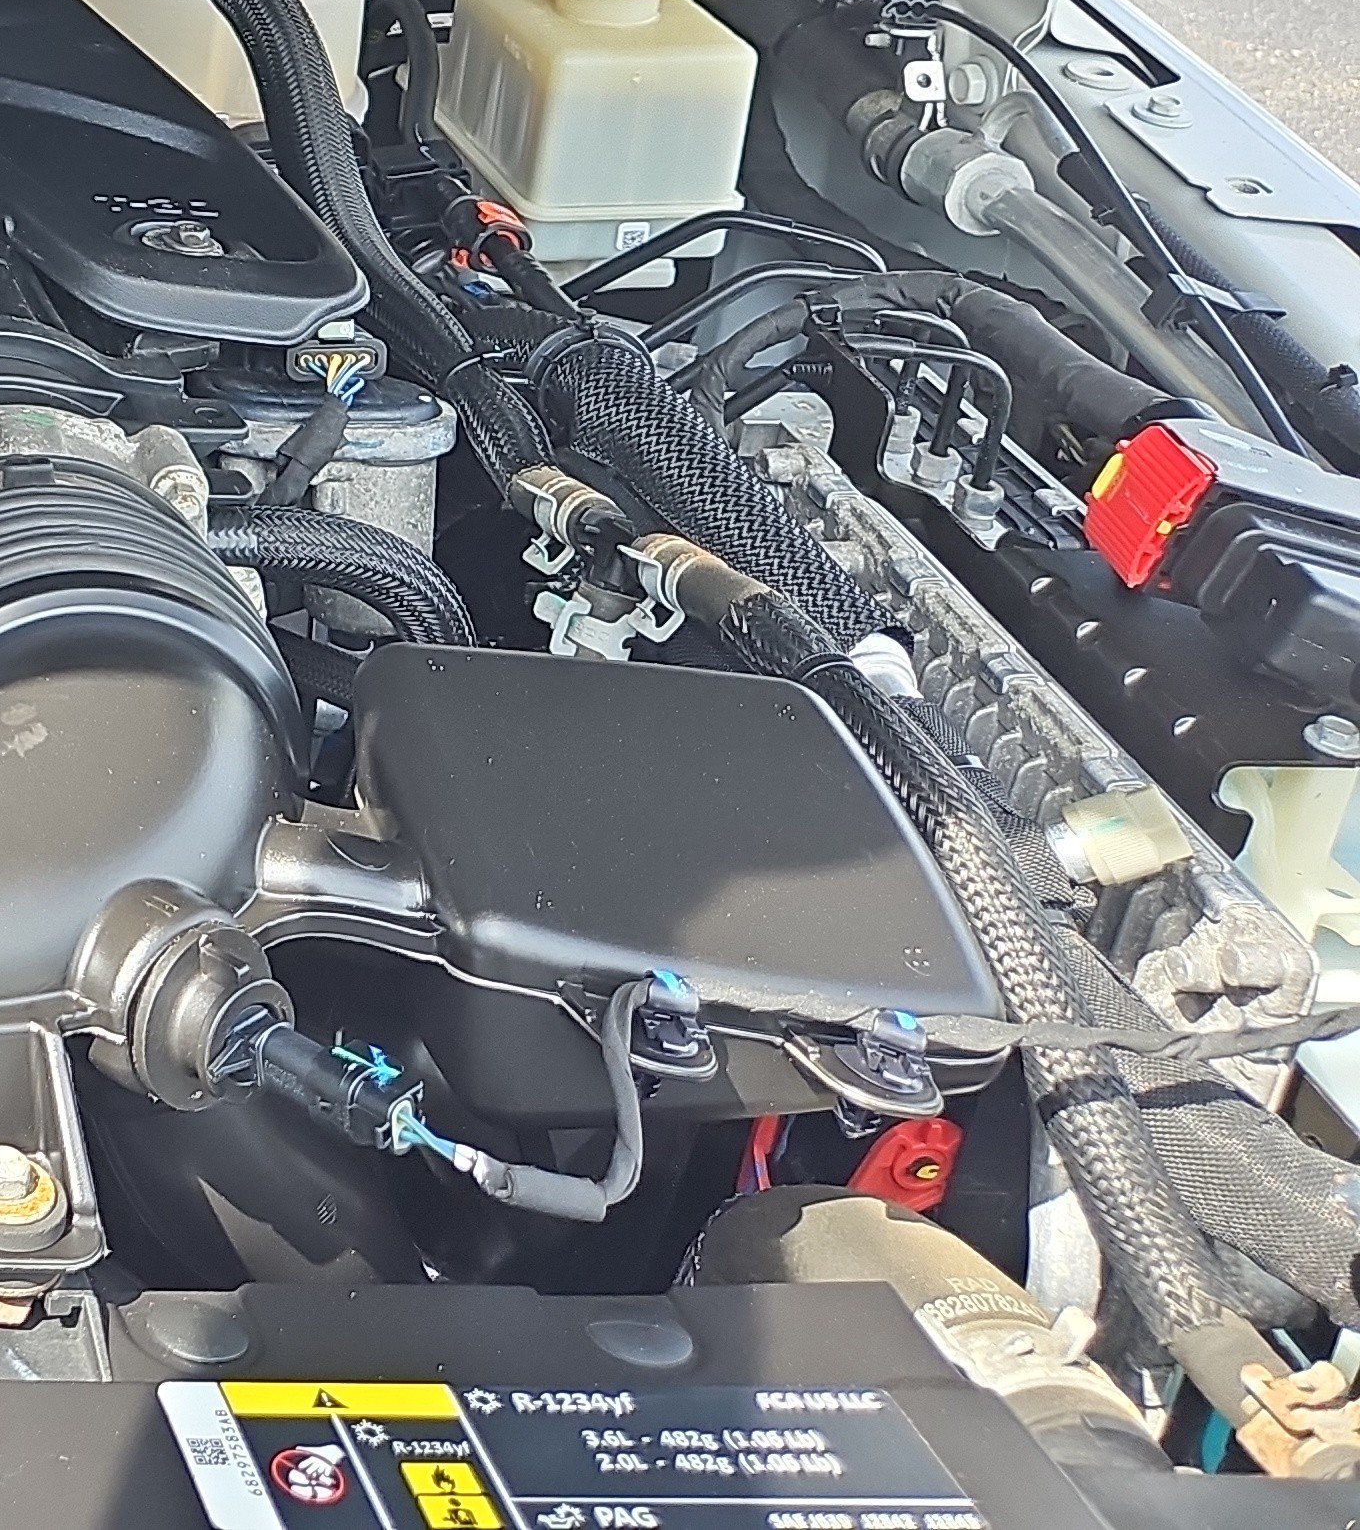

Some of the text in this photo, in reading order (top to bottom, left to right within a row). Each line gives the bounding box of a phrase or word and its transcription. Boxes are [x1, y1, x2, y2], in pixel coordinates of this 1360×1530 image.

[511, 1392, 634, 1416] R-1234yf
[756, 1392, 804, 1410] FCA
[392, 1440, 470, 1457] R-1234yf
[582, 1430, 633, 1447] 3.6L
[660, 1430, 719, 1450] 482g
[215, 1409, 262, 1496] 68297583AB
[596, 1453, 648, 1471] 2.0L
[675, 1453, 734, 1473] 482g
[593, 1507, 658, 1528] PAG
